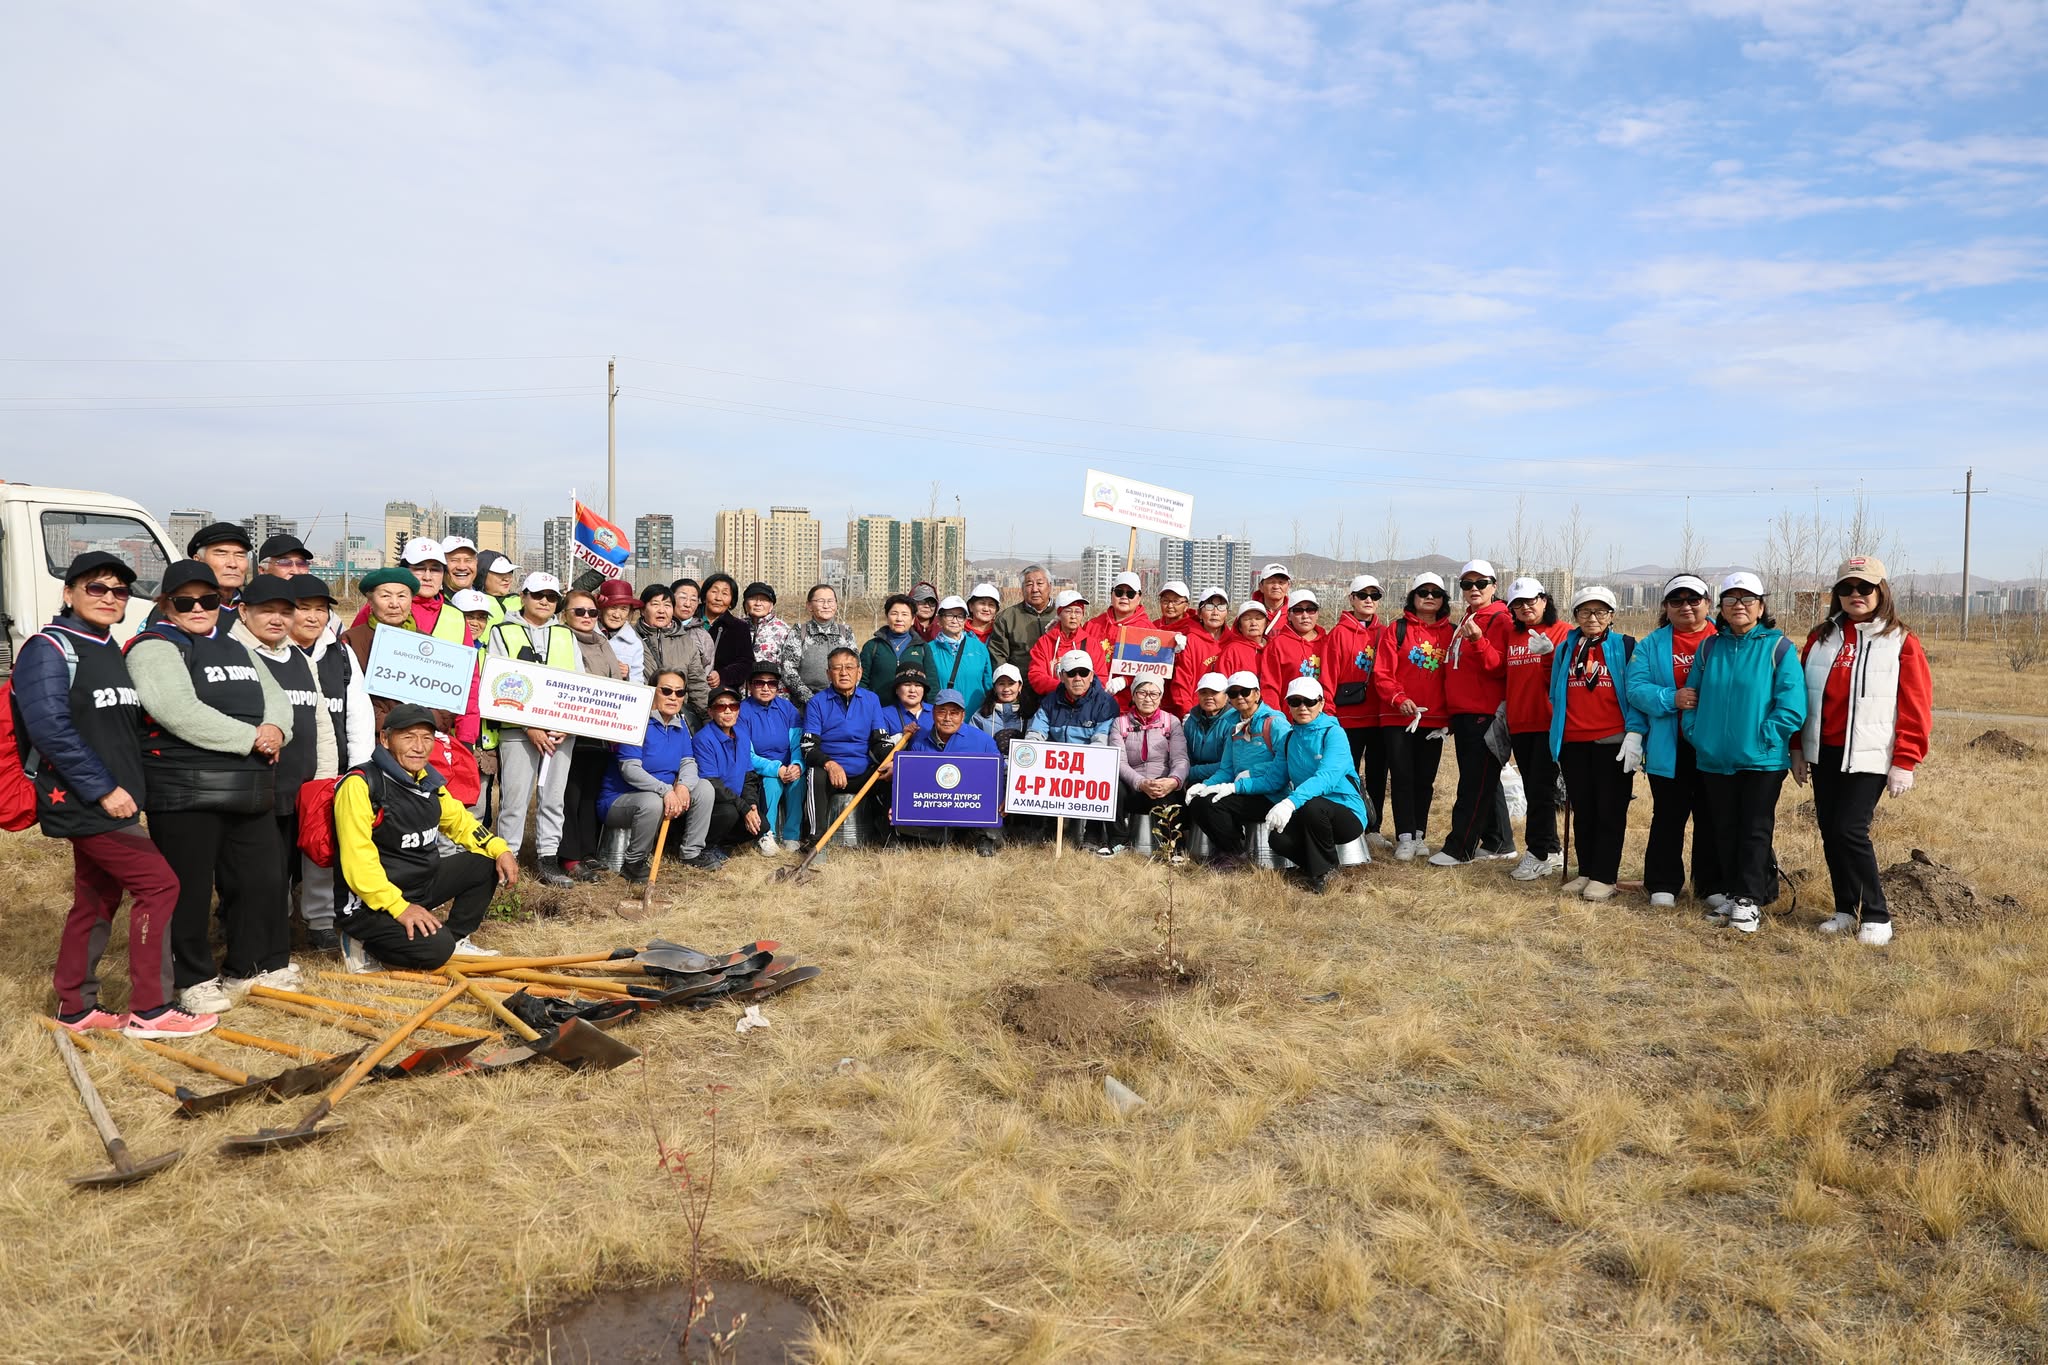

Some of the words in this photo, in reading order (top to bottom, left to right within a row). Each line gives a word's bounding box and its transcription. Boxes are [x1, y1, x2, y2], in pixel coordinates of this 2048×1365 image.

[574, 542, 619, 578] 1-ХОРОО
[542, 575, 552, 583] 37
[472, 594, 483, 602] 37
[204, 666, 226, 683] 23
[375, 666, 406, 682] 23-Р
[409, 674, 462, 696] ХОРОО
[93, 689, 116, 708] 23
[545, 679, 591, 694] БАЯНЗҮРХ
[592, 688, 637, 703] ДҮҮРГИЙН
[557, 692, 576, 702] 37-р
[577, 695, 622, 710] ХОРООНЫ
[532, 707, 561, 718] ЯВГАН
[561, 712, 609, 727] АЛХАЛТЫН
[588, 708, 619, 720] АЯЛАЛ,
[1045, 750, 1085, 775] БЗД
[913, 792, 952, 800] БАЯНЗҮРХ
[953, 793, 982, 801] ДҮҮРЭГ
[1015, 775, 1045, 795] 4-Р
[1049, 777, 1111, 801] ХОРОО
[913, 800, 922, 808] 29
[923, 801, 952, 809] ДҮГЭЭР
[1013, 798, 1065, 809] АХМАДЫН
[1068, 802, 1109, 813] ЗӨВЛӨЛ
[401, 832, 420, 848] 23
